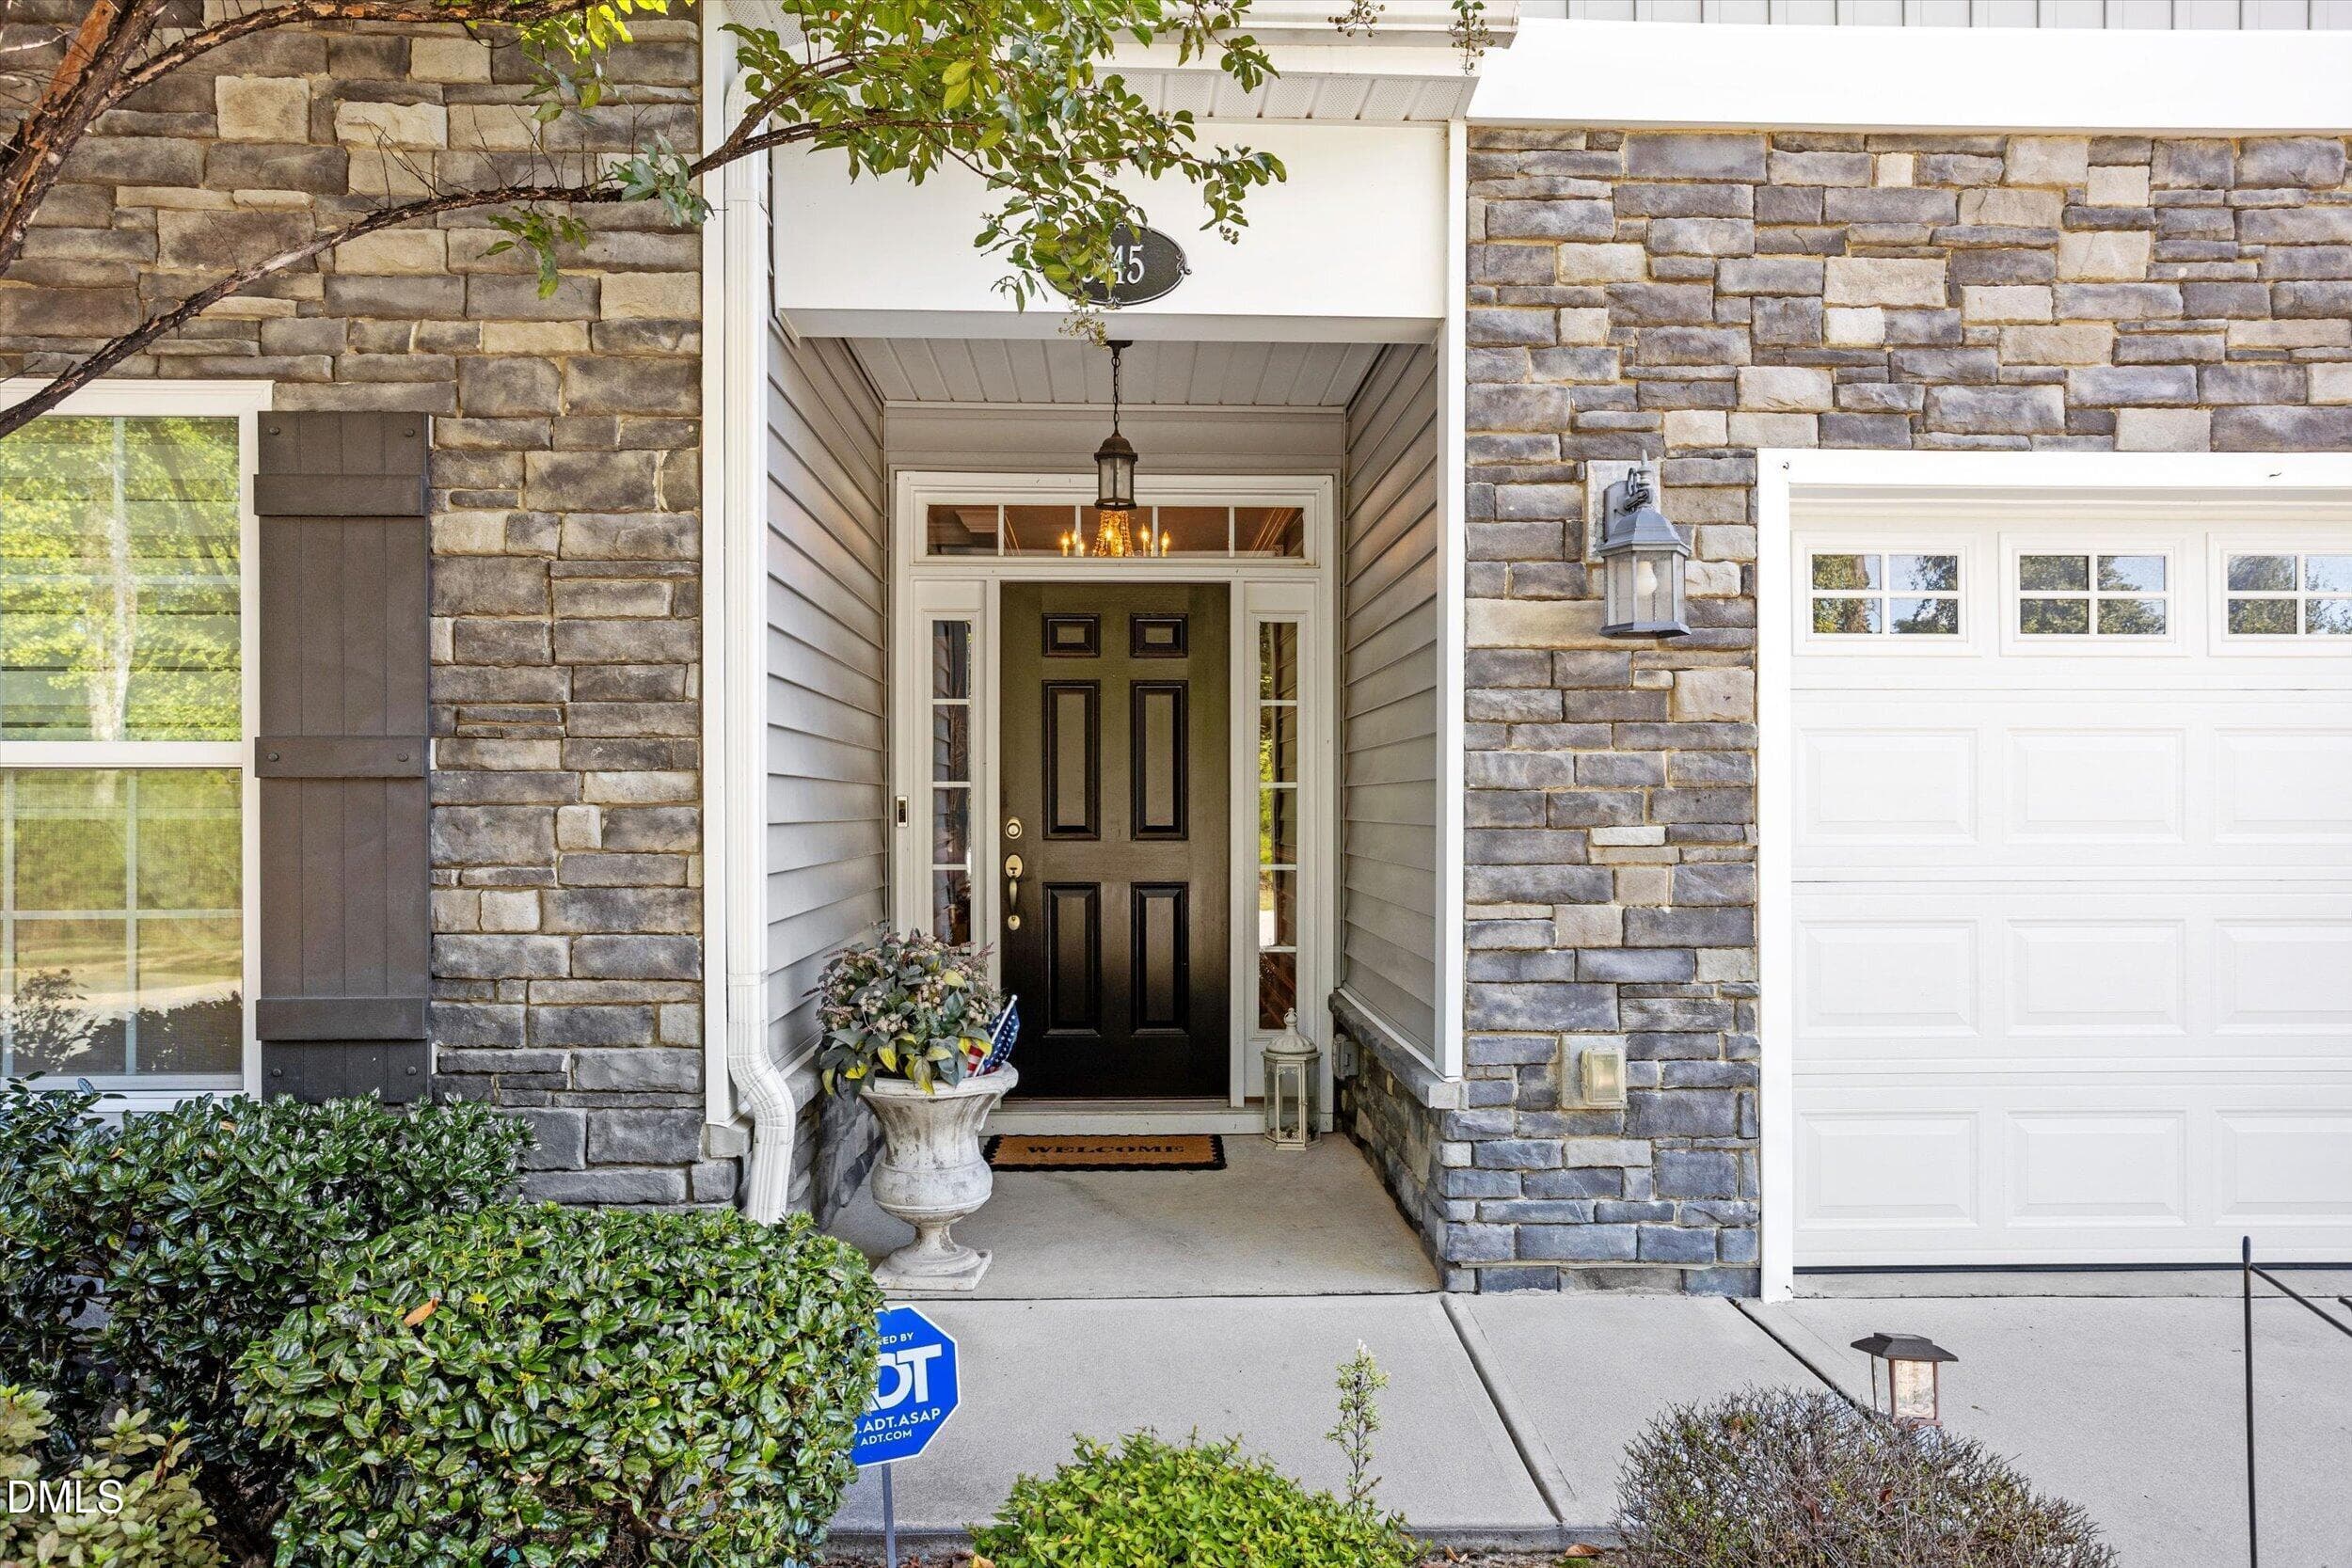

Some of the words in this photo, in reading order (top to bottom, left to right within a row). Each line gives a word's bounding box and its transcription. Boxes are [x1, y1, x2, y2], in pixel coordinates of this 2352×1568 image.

[1082, 244, 1145, 285] 45
[1027, 1144, 1184, 1154] WELCOME
[900, 1332, 914, 1342] BY
[870, 1343, 942, 1411] DT
[860, 1429, 913, 1446] ADT.COM
